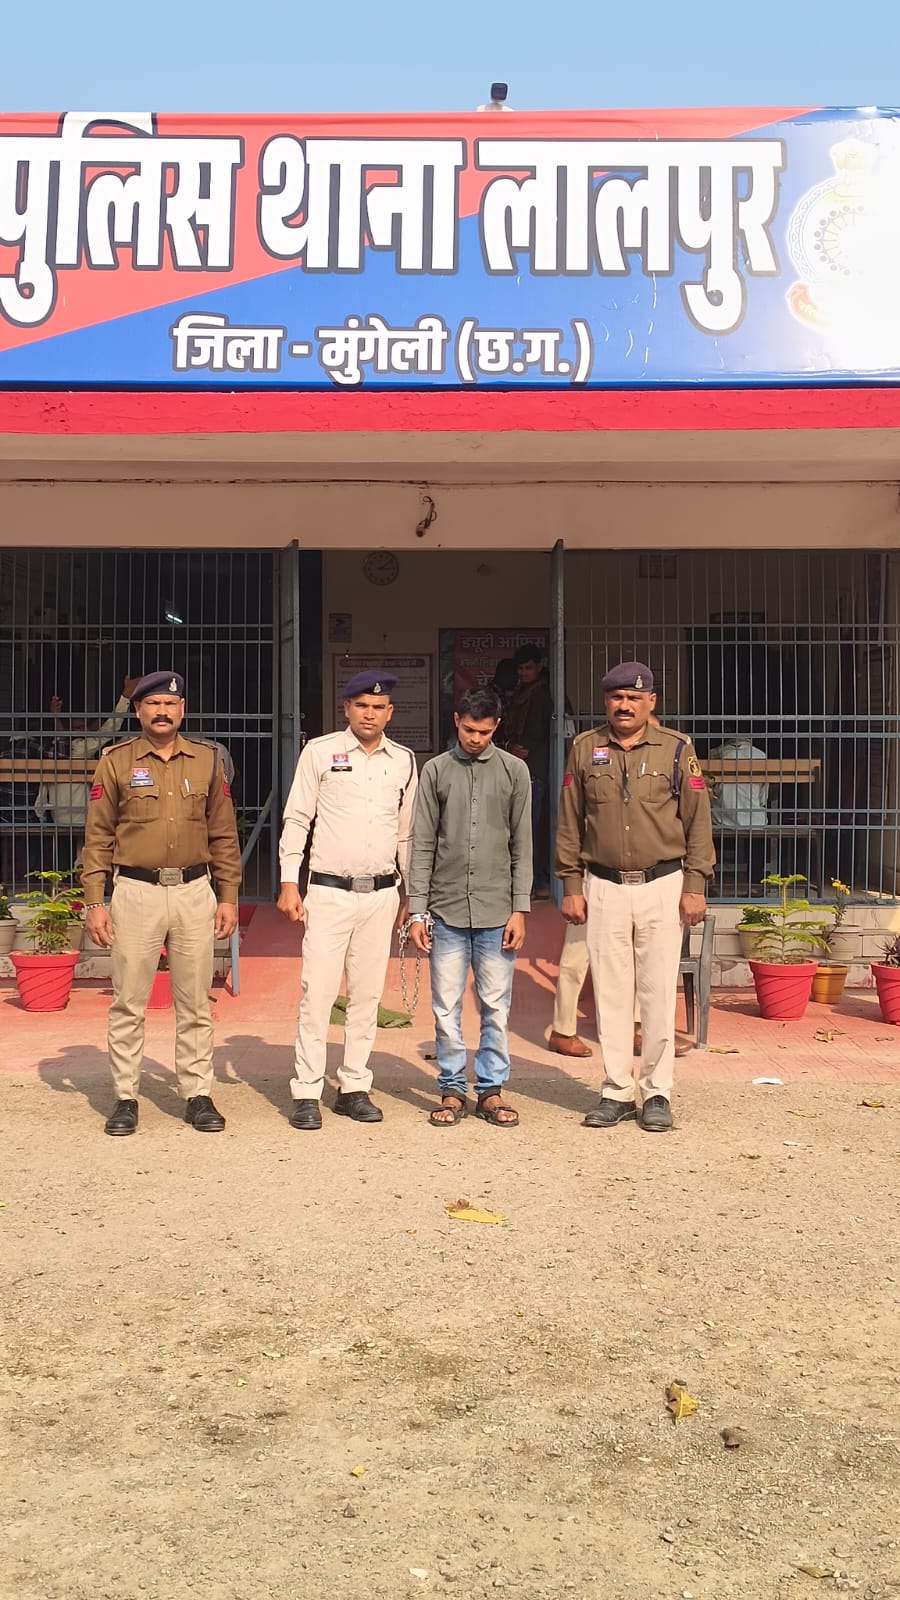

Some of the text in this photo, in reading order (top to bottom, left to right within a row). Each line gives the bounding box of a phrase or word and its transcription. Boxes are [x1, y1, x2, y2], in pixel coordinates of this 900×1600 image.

[0, 112, 784, 334] पुलिस थाना लालपुर
[172, 314, 286, 371] जिला
[317, 316, 449, 385] मुंगेली
[456, 318, 592, 384] (छ.ग.)
